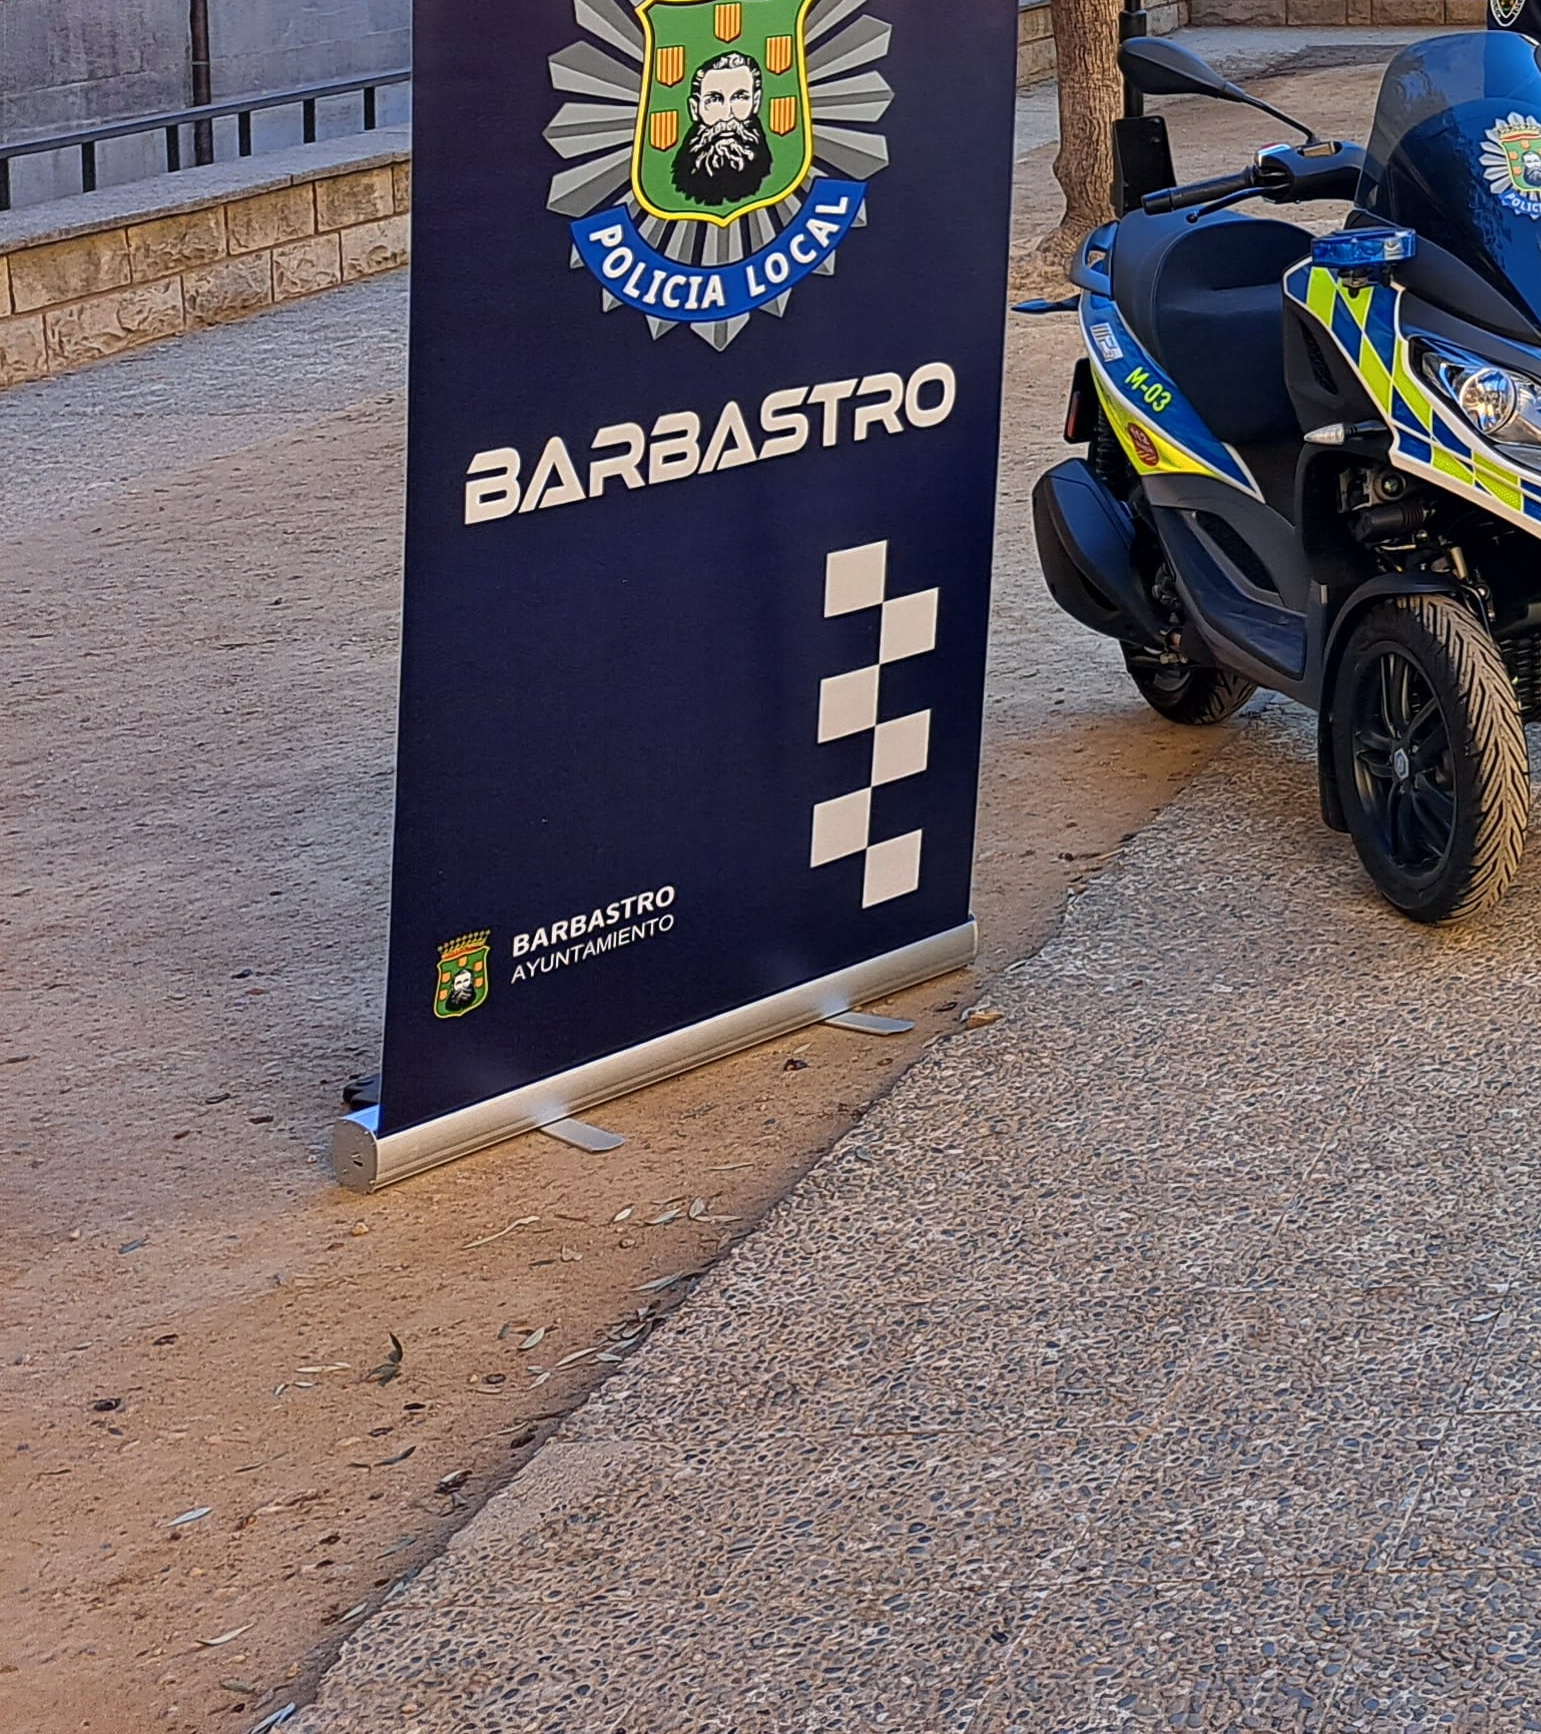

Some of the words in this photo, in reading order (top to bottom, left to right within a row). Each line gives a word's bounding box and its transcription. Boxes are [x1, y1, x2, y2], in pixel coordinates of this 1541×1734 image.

[589, 224, 726, 310] POLICIA
[746, 196, 848, 297] LOCAL
[1124, 366, 1172, 412] M-03
[464, 362, 956, 526] BARBASTRO
[510, 914, 675, 985] AYUNTAMIENTO
[512, 885, 676, 958] BARBASTRO
